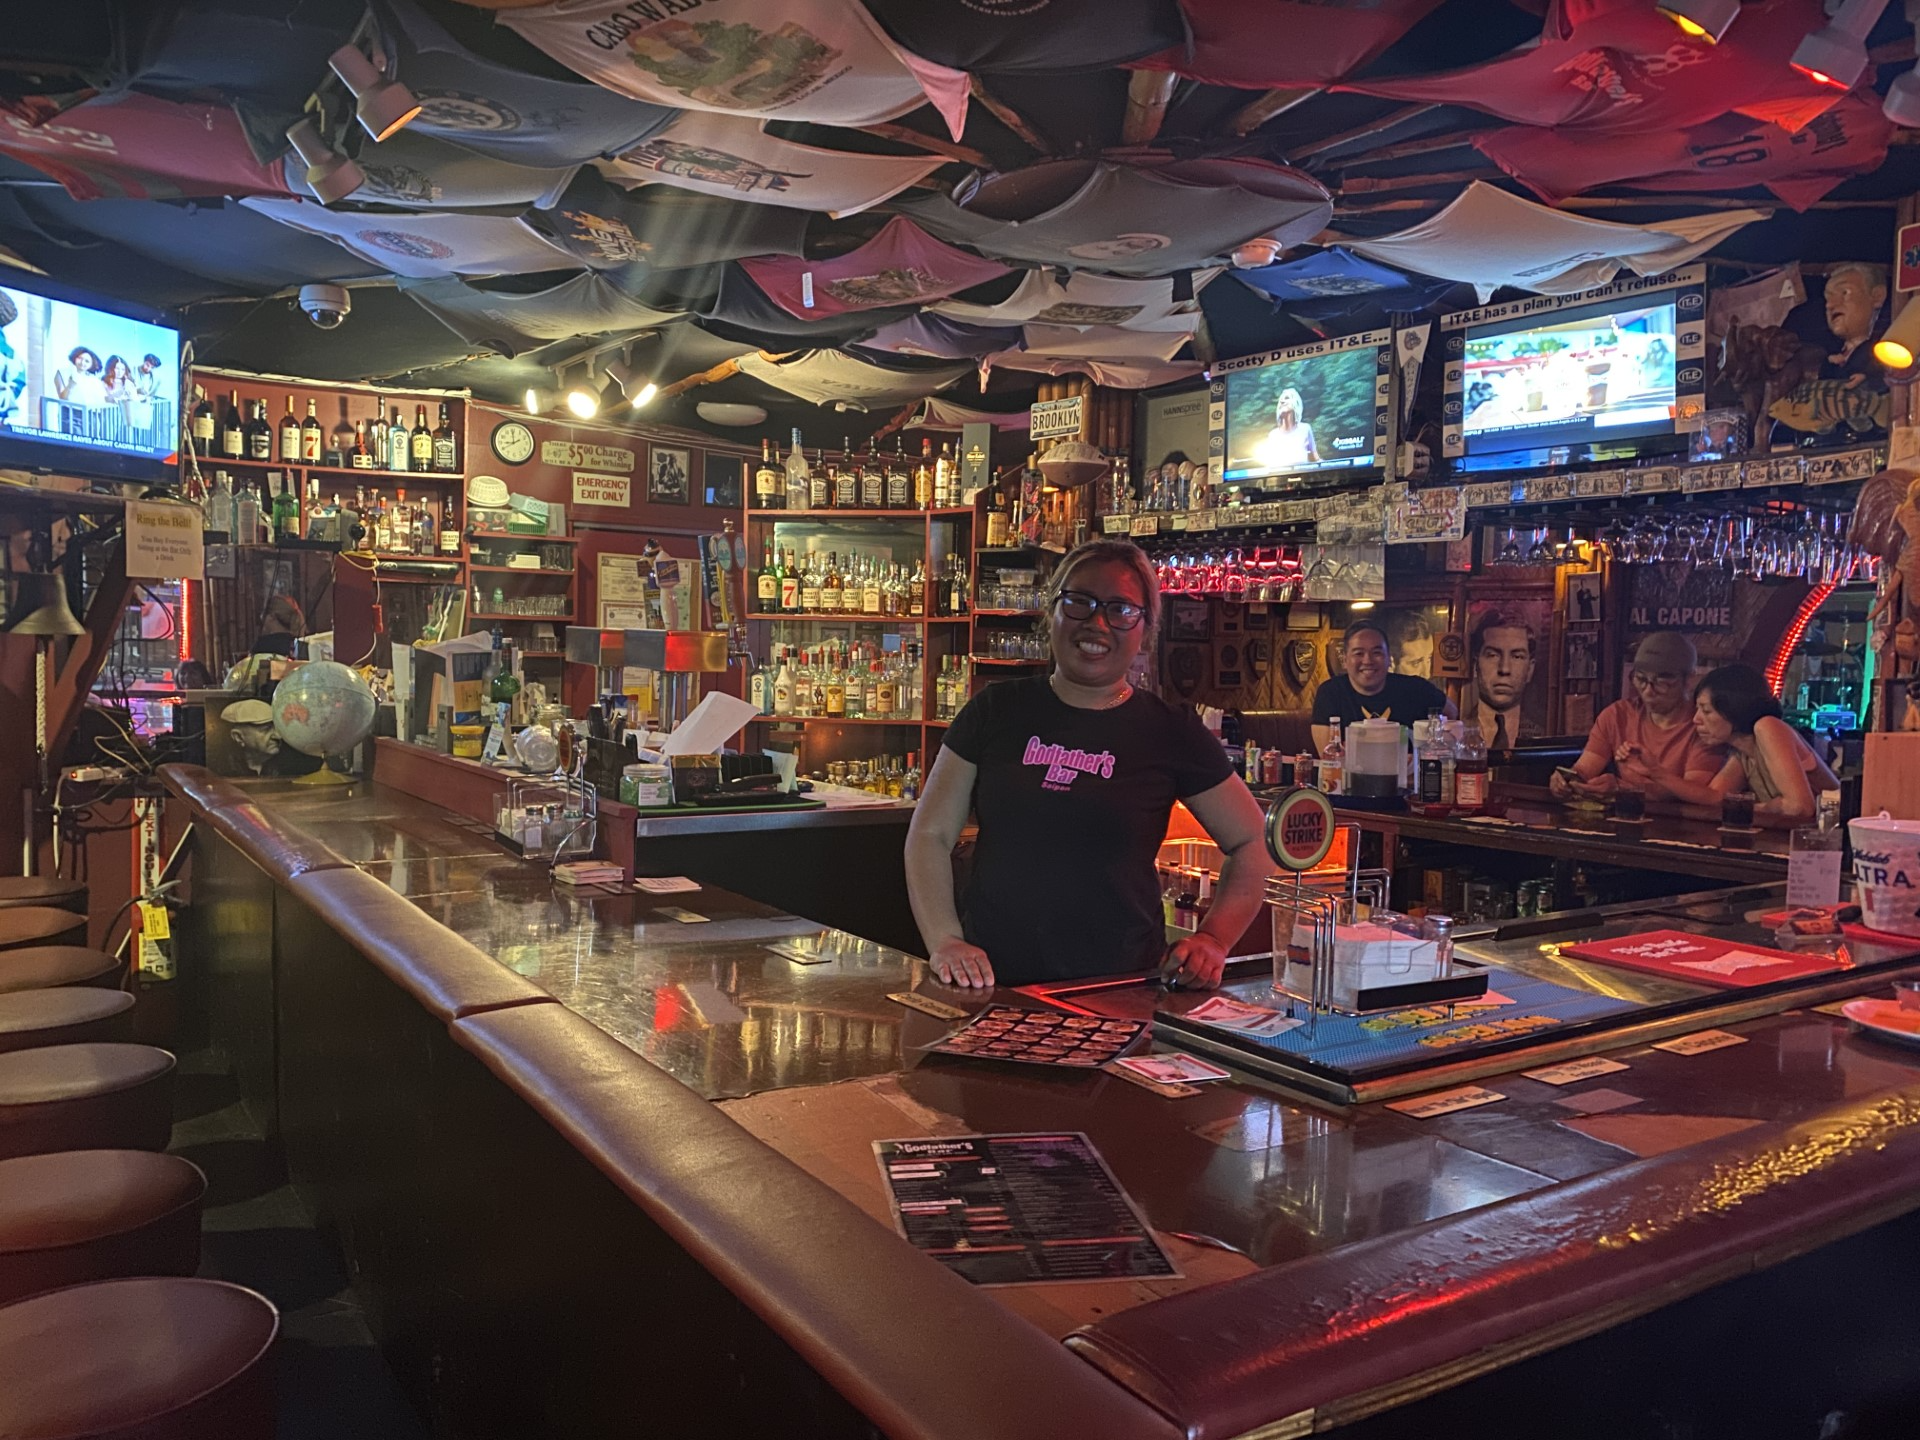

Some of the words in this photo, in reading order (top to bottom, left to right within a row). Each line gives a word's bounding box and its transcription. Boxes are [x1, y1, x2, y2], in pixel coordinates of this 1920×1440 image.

[586, 12, 642, 50] CABO
[1449, 310, 1481, 326] IT&E
[1484, 305, 1507, 319] has
[1511, 304, 1520, 314] a
[1523, 298, 1553, 314] plan
[1556, 292, 1582, 309] you
[1586, 278, 1623, 299] can't
[1627, 273, 1692, 291] refuse...
[1218, 354, 1266, 372] Scotty
[1271, 351, 1282, 361] D
[1287, 345, 1324, 359] uses
[1329, 334, 1389, 350] IT&E...
[1032, 408, 1079, 431] BROOKLYN
[12, 427, 38, 437] TREVOR
[39, 430, 72, 442] LAWRENCE
[93, 438, 114, 448] ABOUT
[595, 445, 627, 461] Charge
[591, 458, 601, 466] for
[602, 460, 632, 471] Whining
[577, 477, 628, 490] EMERGENCY
[581, 489, 600, 500] EXIT
[602, 491, 625, 502] ONLY
[137, 513, 156, 527] Ring
[158, 516, 170, 526] the
[784, 585, 796, 606] 7
[1629, 607, 1651, 624] AL
[1657, 607, 1731, 625] CAPONE
[1023, 735, 1115, 779] Godfather's
[1045, 764, 1078, 784] Bar
[1041, 781, 1070, 791] Saipan
[1287, 812, 1323, 828] LUCKY
[1285, 828, 1323, 844] STRIKE
[904, 1142, 973, 1153] Godfather's
